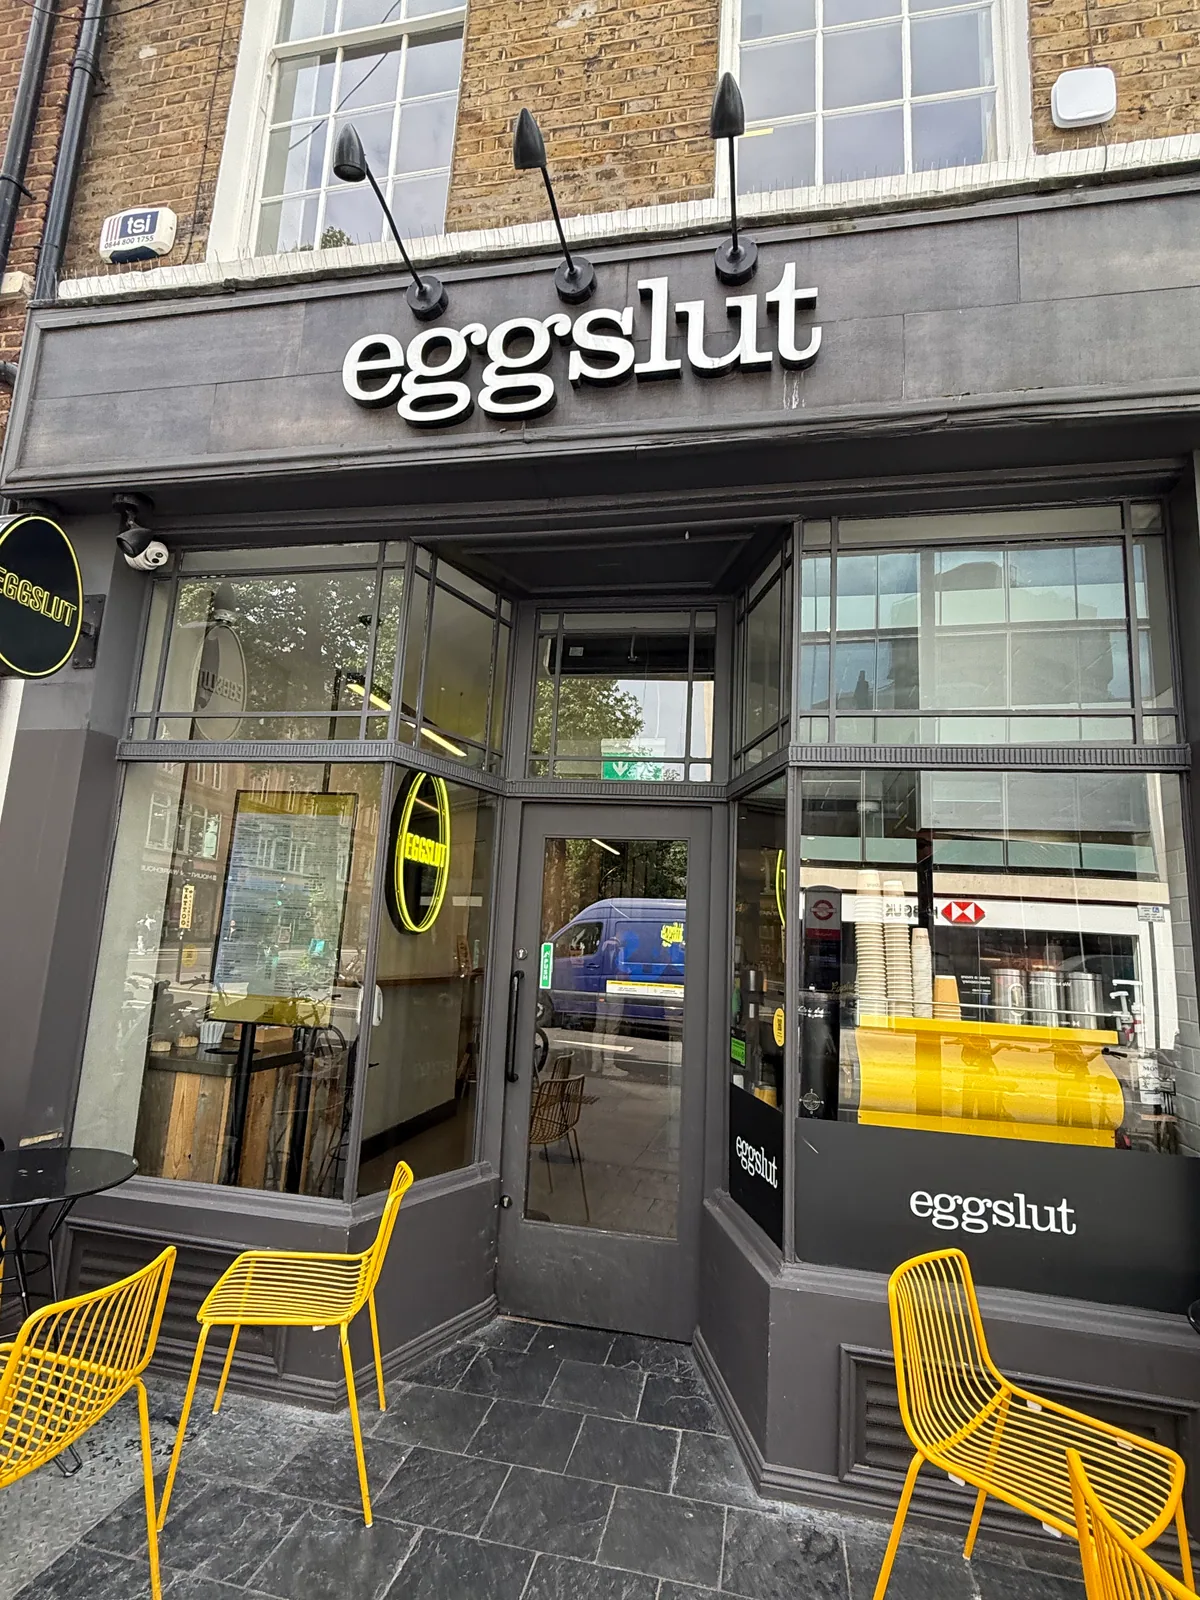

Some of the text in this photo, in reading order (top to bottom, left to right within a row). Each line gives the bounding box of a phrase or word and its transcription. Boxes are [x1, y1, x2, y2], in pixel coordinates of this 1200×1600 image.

[104, 234, 154, 249] 0844 800 1755
[127, 214, 151, 234] tsi
[341, 262, 822, 424] eggslut
[405, 832, 447, 868] EGGSLUT
[735, 1135, 778, 1189] eggslut
[909, 1190, 1077, 1235] eggslut
